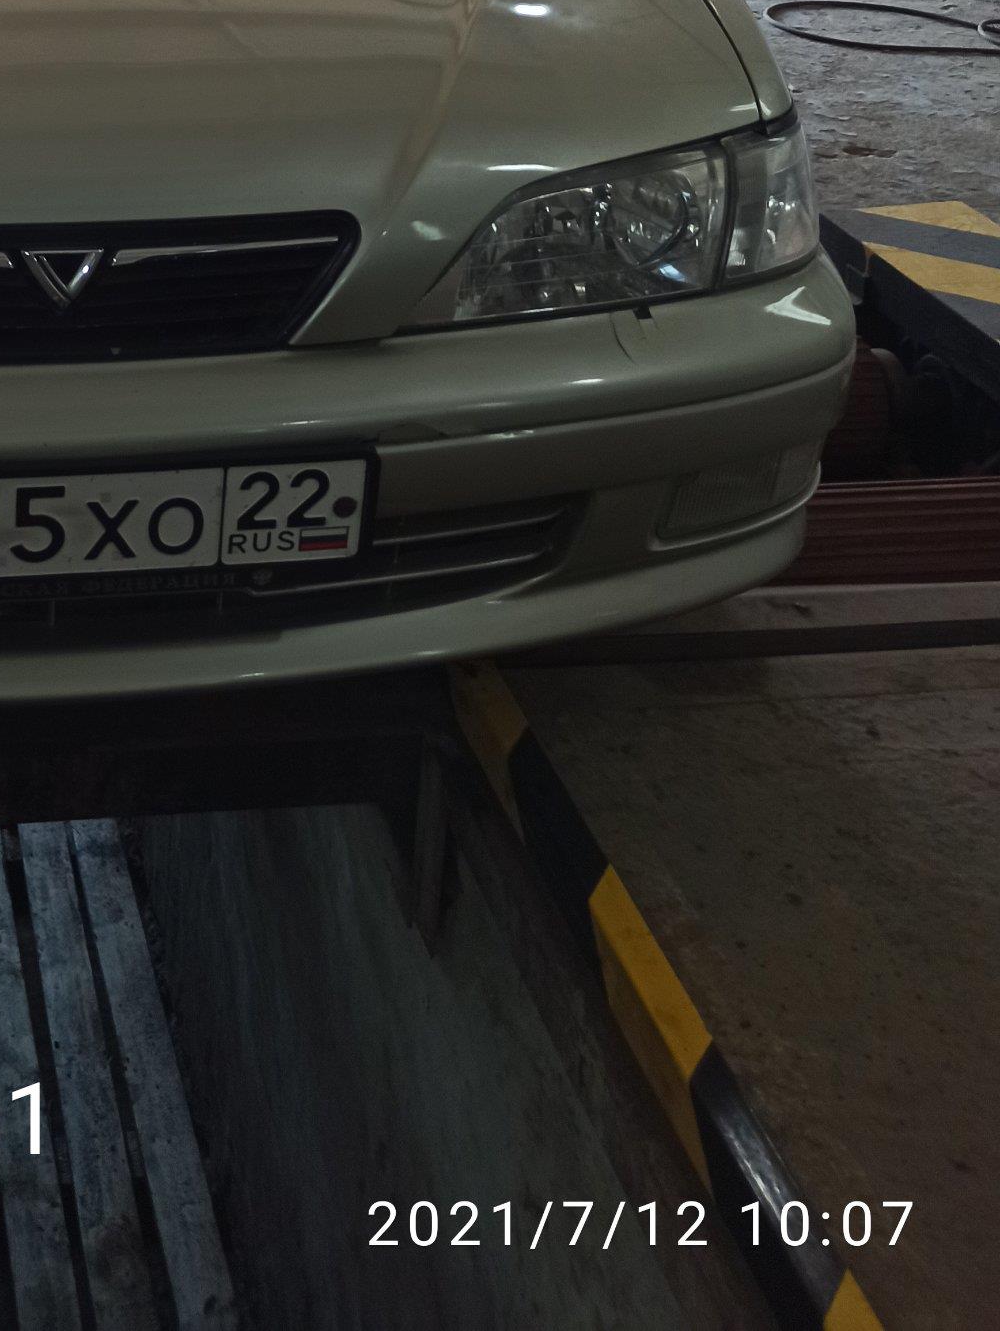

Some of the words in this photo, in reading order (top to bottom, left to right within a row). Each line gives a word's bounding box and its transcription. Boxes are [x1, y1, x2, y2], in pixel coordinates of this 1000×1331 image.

[236, 470, 331, 530] 22
[228, 529, 296, 555] RUS
[81, 572, 238, 595] ФЕДЕРАЦИЯ
